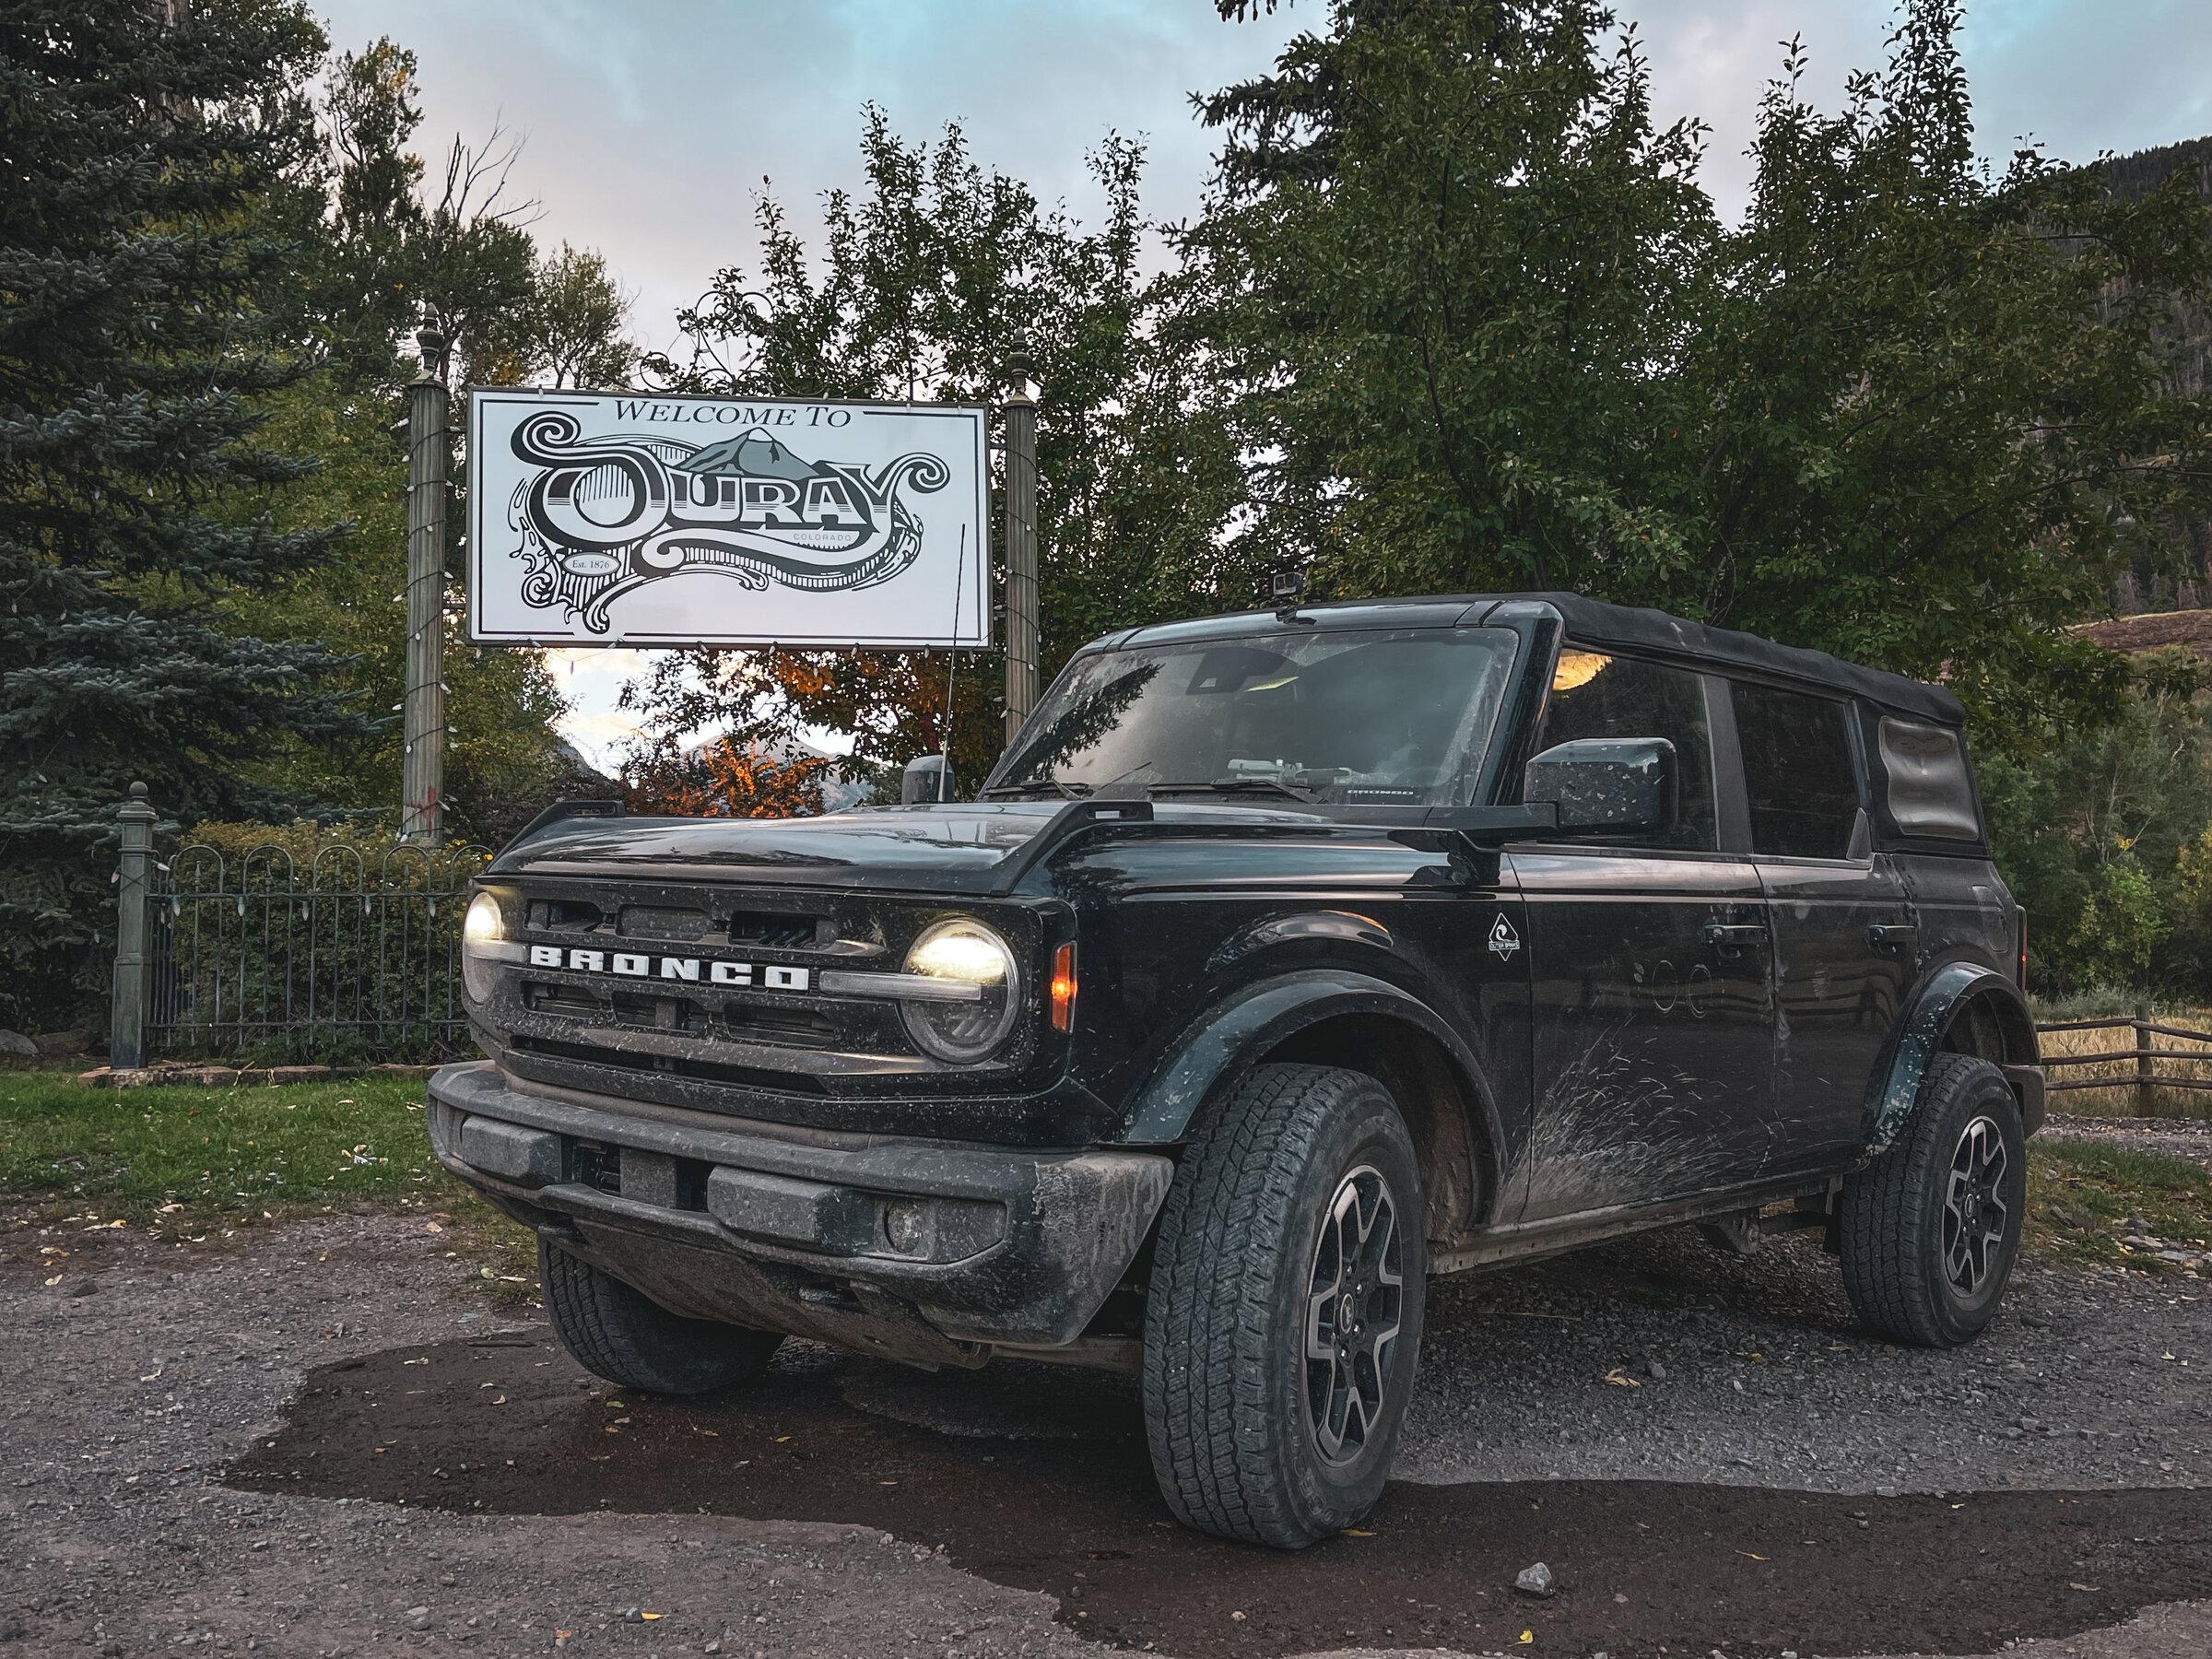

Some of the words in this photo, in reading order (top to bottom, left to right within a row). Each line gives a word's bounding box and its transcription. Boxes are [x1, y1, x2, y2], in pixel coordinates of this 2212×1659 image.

[614, 399, 797, 426] WELCOME
[806, 406, 853, 428] TO
[512, 429, 949, 550] OURAY
[793, 533, 852, 542] COLORADO
[571, 559, 587, 569] Est.
[590, 559, 610, 570] 1876
[530, 945, 810, 991] BRONCO
